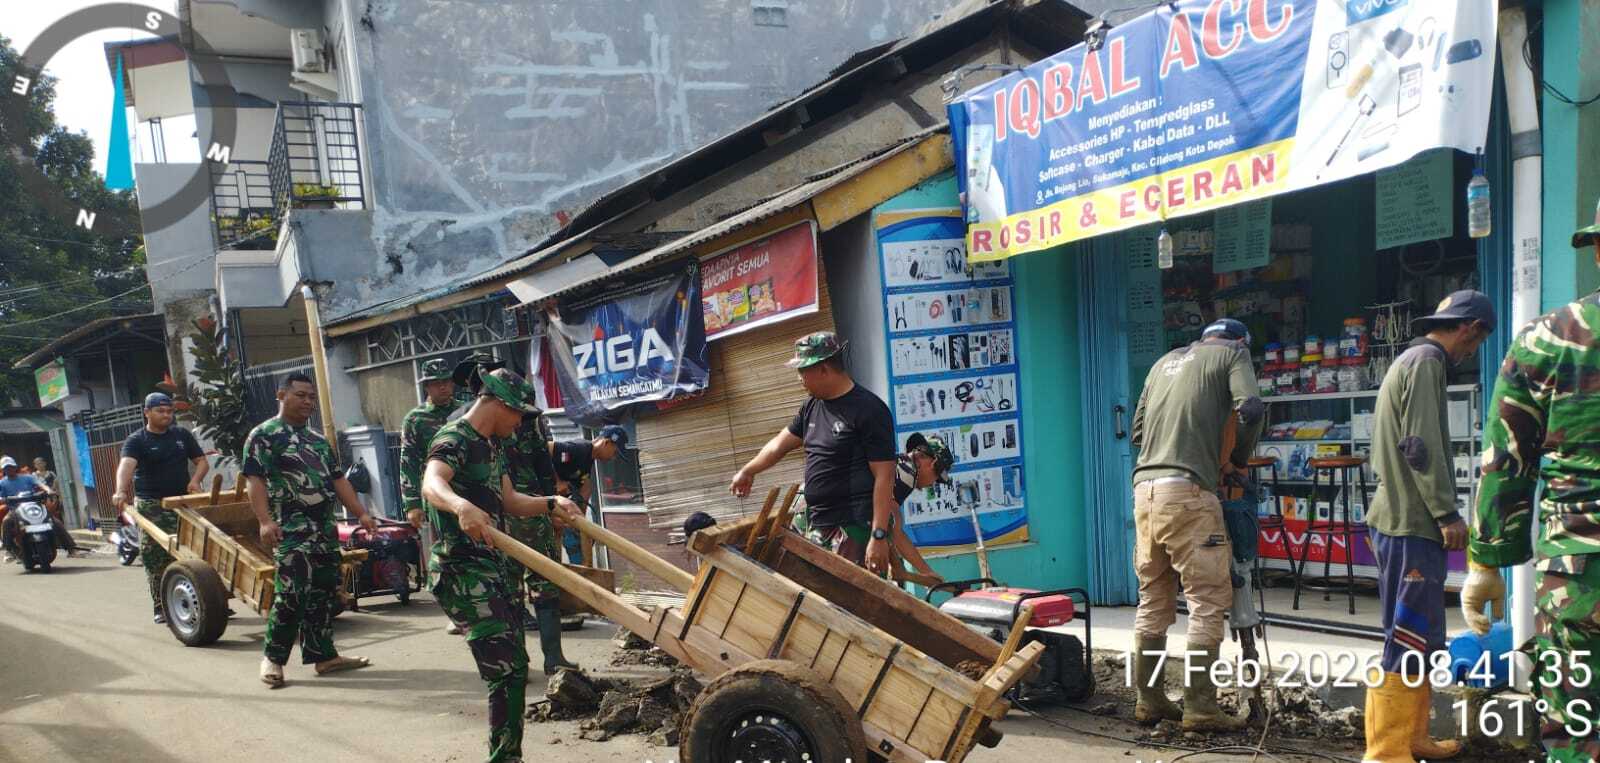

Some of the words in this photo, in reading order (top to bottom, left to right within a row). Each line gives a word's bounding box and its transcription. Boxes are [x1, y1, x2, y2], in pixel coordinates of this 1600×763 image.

[994, 37, 1140, 142] IQBAL
[1160, 0, 1293, 79] ACC
[1088, 98, 1156, 130] Menyediakan
[1039, 163, 1076, 182] Softcase
[1084, 147, 1125, 168] Charger
[1133, 131, 1165, 152] Kabel
[1167, 124, 1195, 142] Data
[1205, 112, 1230, 131] DLL
[1049, 134, 1109, 161] Accessories
[1110, 125, 1126, 143] HP
[1185, 144, 1206, 157] Kota
[1207, 134, 1236, 151] Depok
[1079, 201, 1098, 229] &
[1119, 153, 1275, 219] ECERAN
[736, 251, 770, 276] SEMUA
[572, 326, 674, 379] ZIGA
